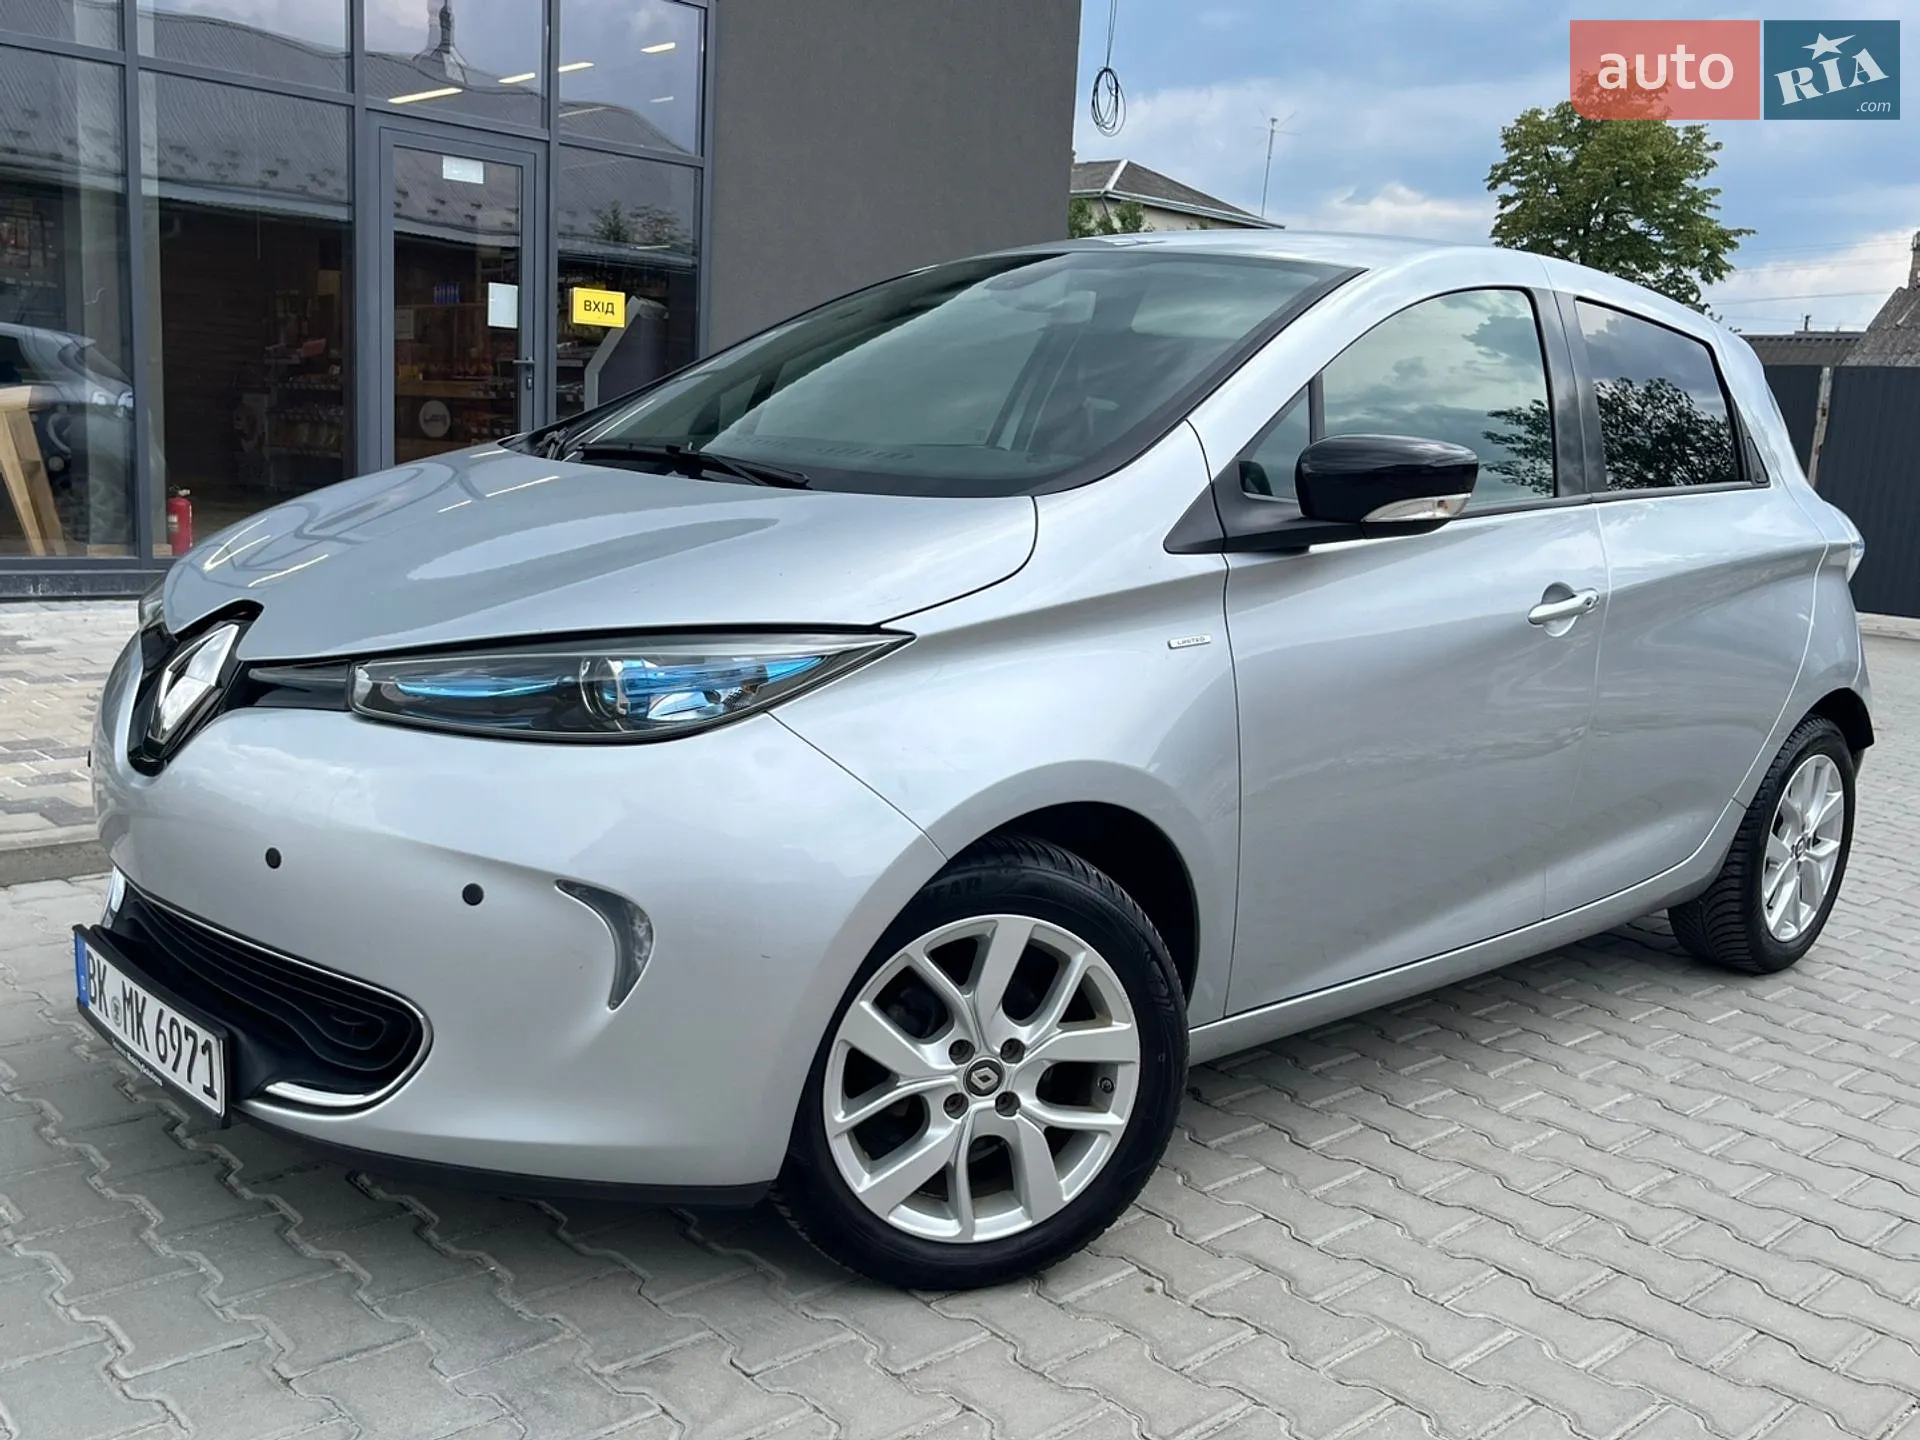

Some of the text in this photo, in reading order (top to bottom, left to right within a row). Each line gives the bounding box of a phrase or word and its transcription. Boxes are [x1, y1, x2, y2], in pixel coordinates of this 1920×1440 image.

[583, 299, 615, 316] ВХІД
[87, 949, 111, 1019] BK
[121, 980, 150, 1052] MK
[154, 1008, 218, 1101] 6971
